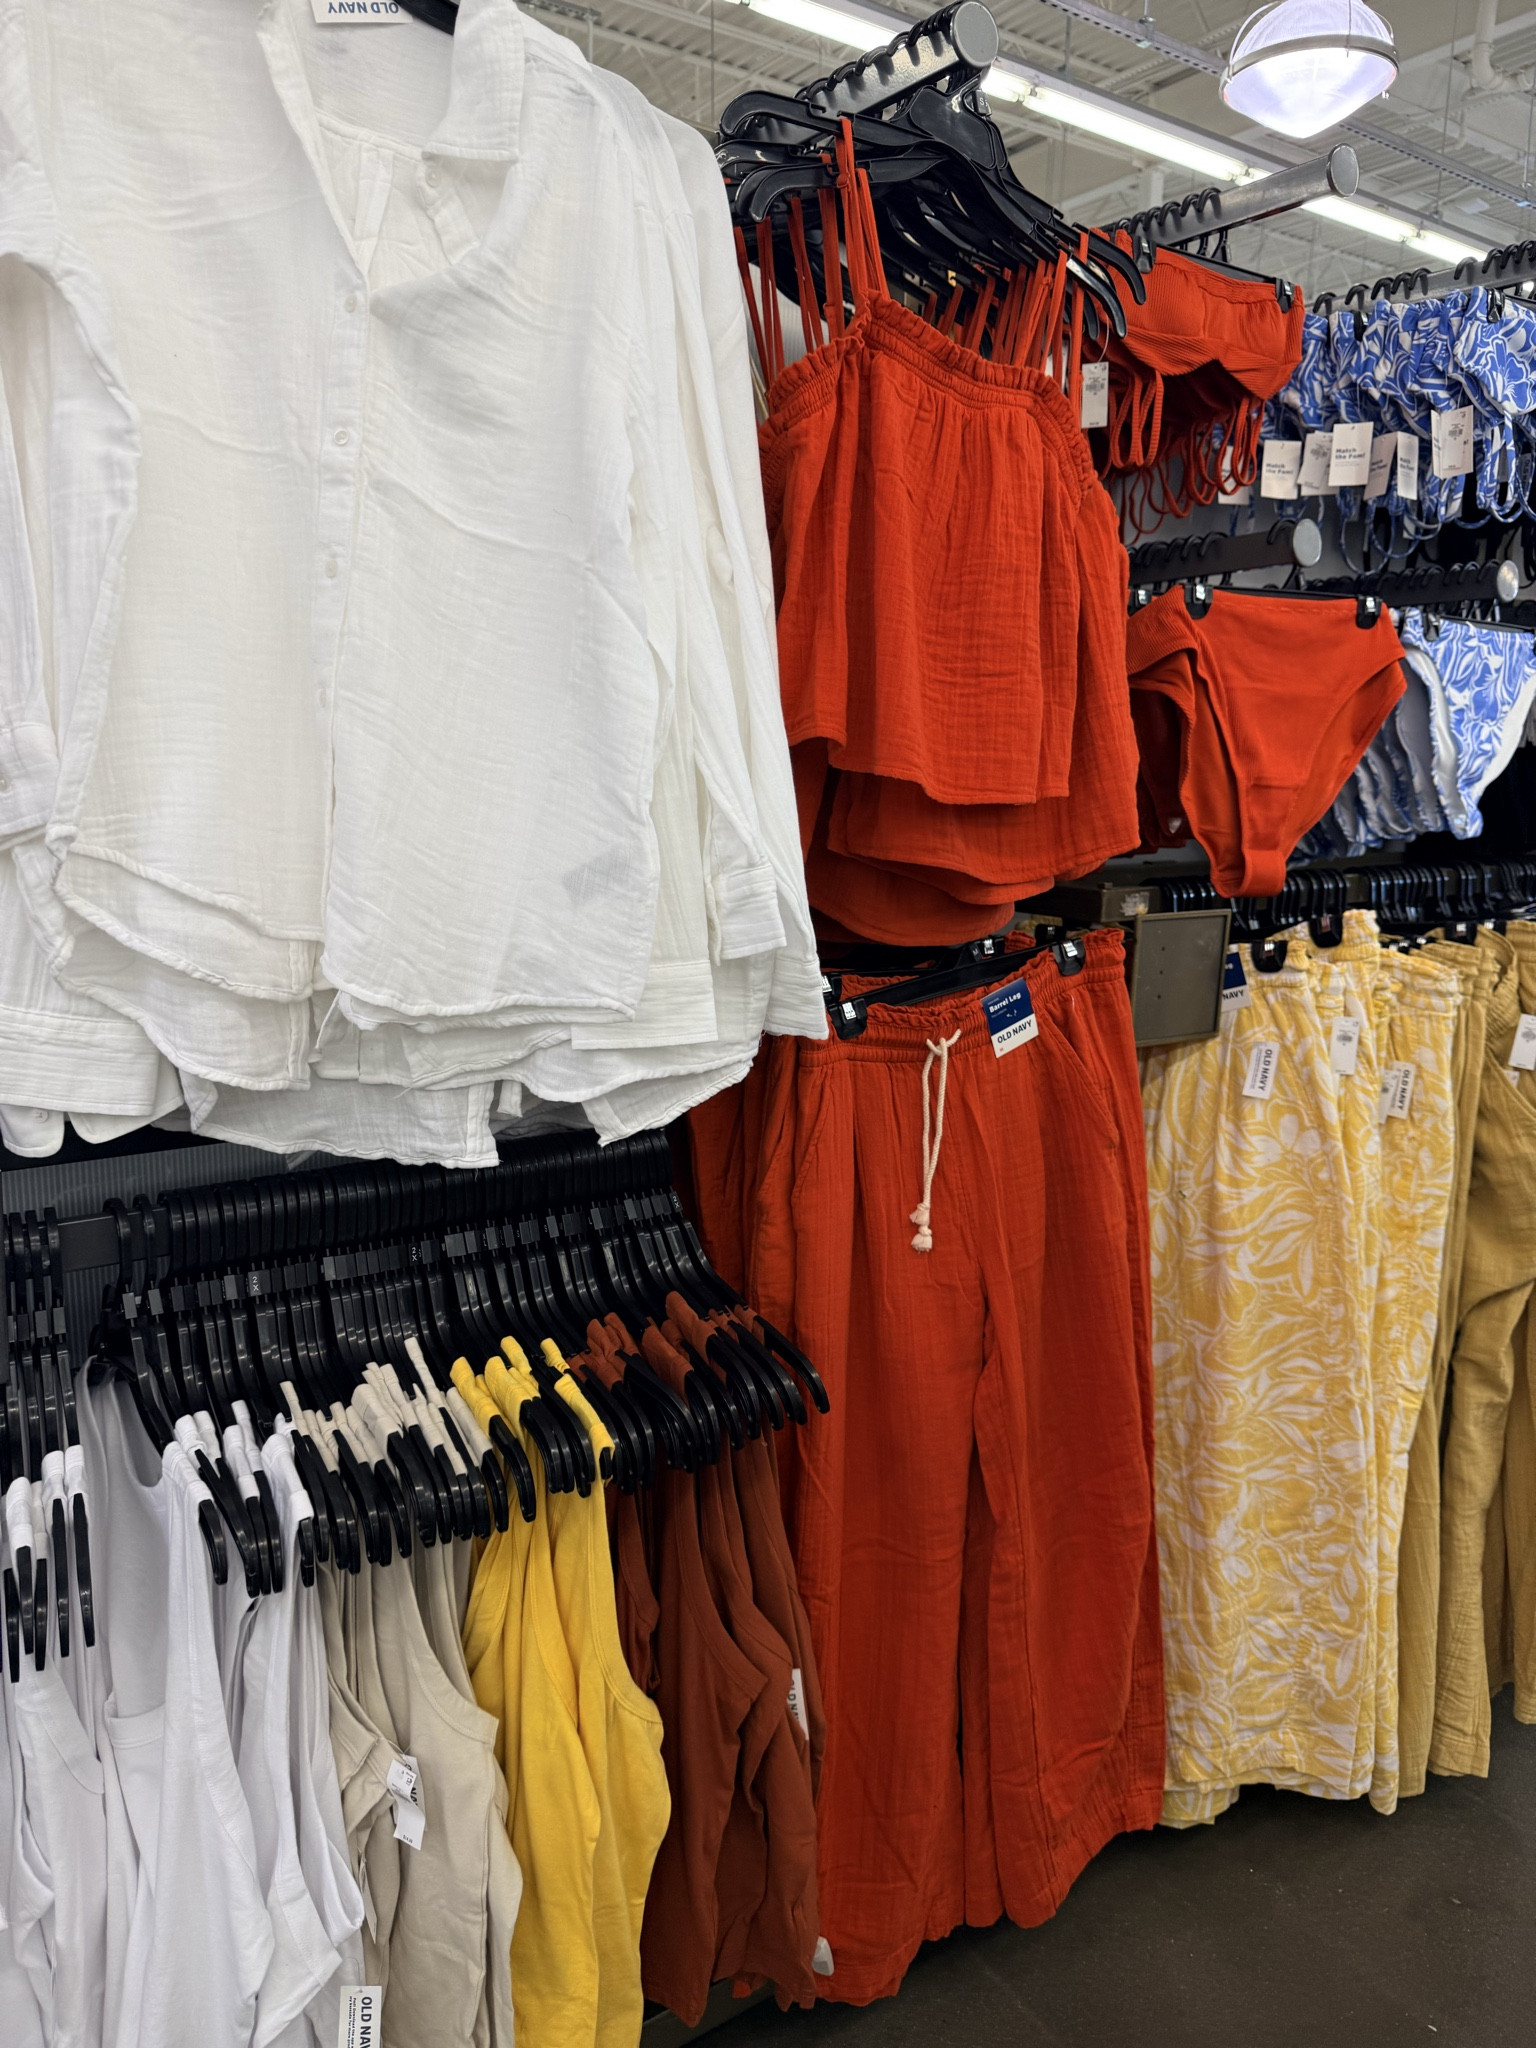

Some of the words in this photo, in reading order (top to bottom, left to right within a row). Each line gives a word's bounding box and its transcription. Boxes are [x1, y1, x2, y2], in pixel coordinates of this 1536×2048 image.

[328, 2, 368, 14] NAVY
[371, 2, 399, 14] OLD
[989, 999, 1009, 1013] Barrel
[1009, 992, 1022, 1002] Leg
[1222, 990, 1244, 1000] NAVY
[997, 1031, 1012, 1044] OLD
[1012, 1019, 1032, 1036] NAVY
[1263, 1049, 1273, 1066] OLD
[1257, 1067, 1270, 1092] NAVY
[1401, 1069, 1411, 1086] OLD
[1397, 1087, 1407, 1111] NAVY
[361, 1996, 373, 2022] OLD
